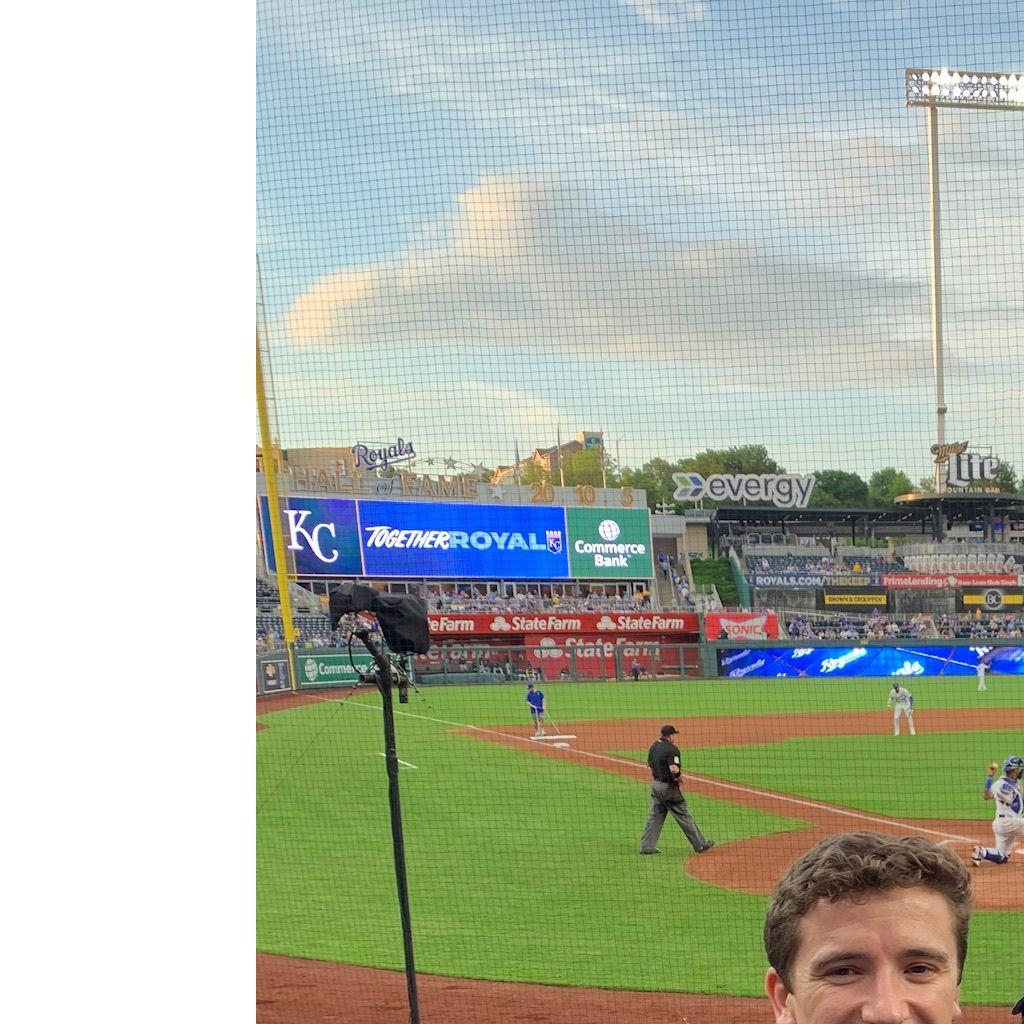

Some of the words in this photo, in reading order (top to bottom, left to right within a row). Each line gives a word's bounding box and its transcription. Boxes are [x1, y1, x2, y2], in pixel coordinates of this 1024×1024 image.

[351, 437, 416, 471] Royals
[289, 464, 370, 495] HALL
[400, 472, 480, 498] FAME
[946, 452, 1000, 487] Lite
[530, 484, 555, 503] 20
[575, 484, 596, 505] 10
[620, 486, 633, 507] 5
[708, 474, 815, 505] evergy
[283, 509, 338, 563] KC
[574, 540, 645, 554] Commerce
[594, 554, 628, 567] Bank
[725, 625, 760, 634] SONIC
[319, 663, 368, 675] Commerce
